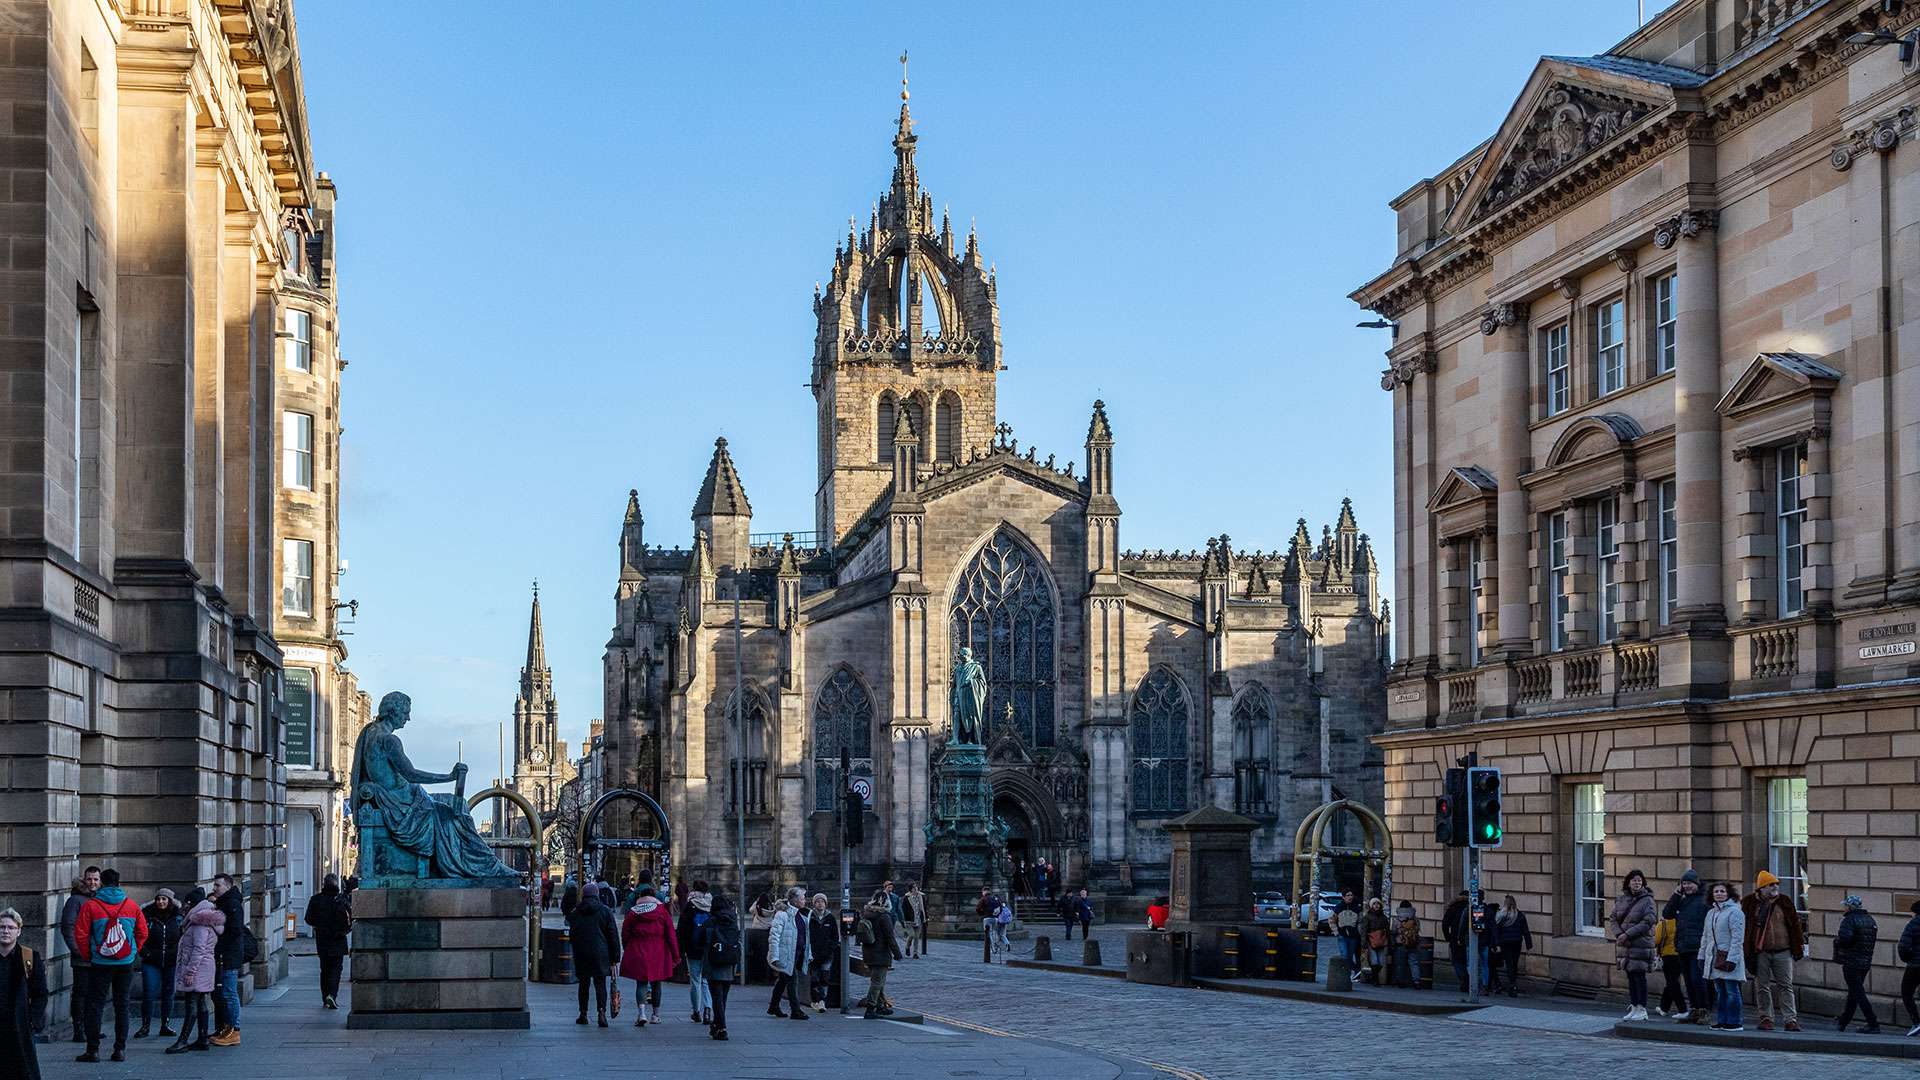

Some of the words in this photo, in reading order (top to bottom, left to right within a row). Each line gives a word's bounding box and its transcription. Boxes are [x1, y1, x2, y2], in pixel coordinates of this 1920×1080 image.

[1861, 630, 1872, 639] THE
[1873, 626, 1896, 637] ROYAL
[1897, 623, 1914, 633] MILE
[1862, 643, 1912, 657] LAWNMARKET
[855, 784, 868, 795] 20
